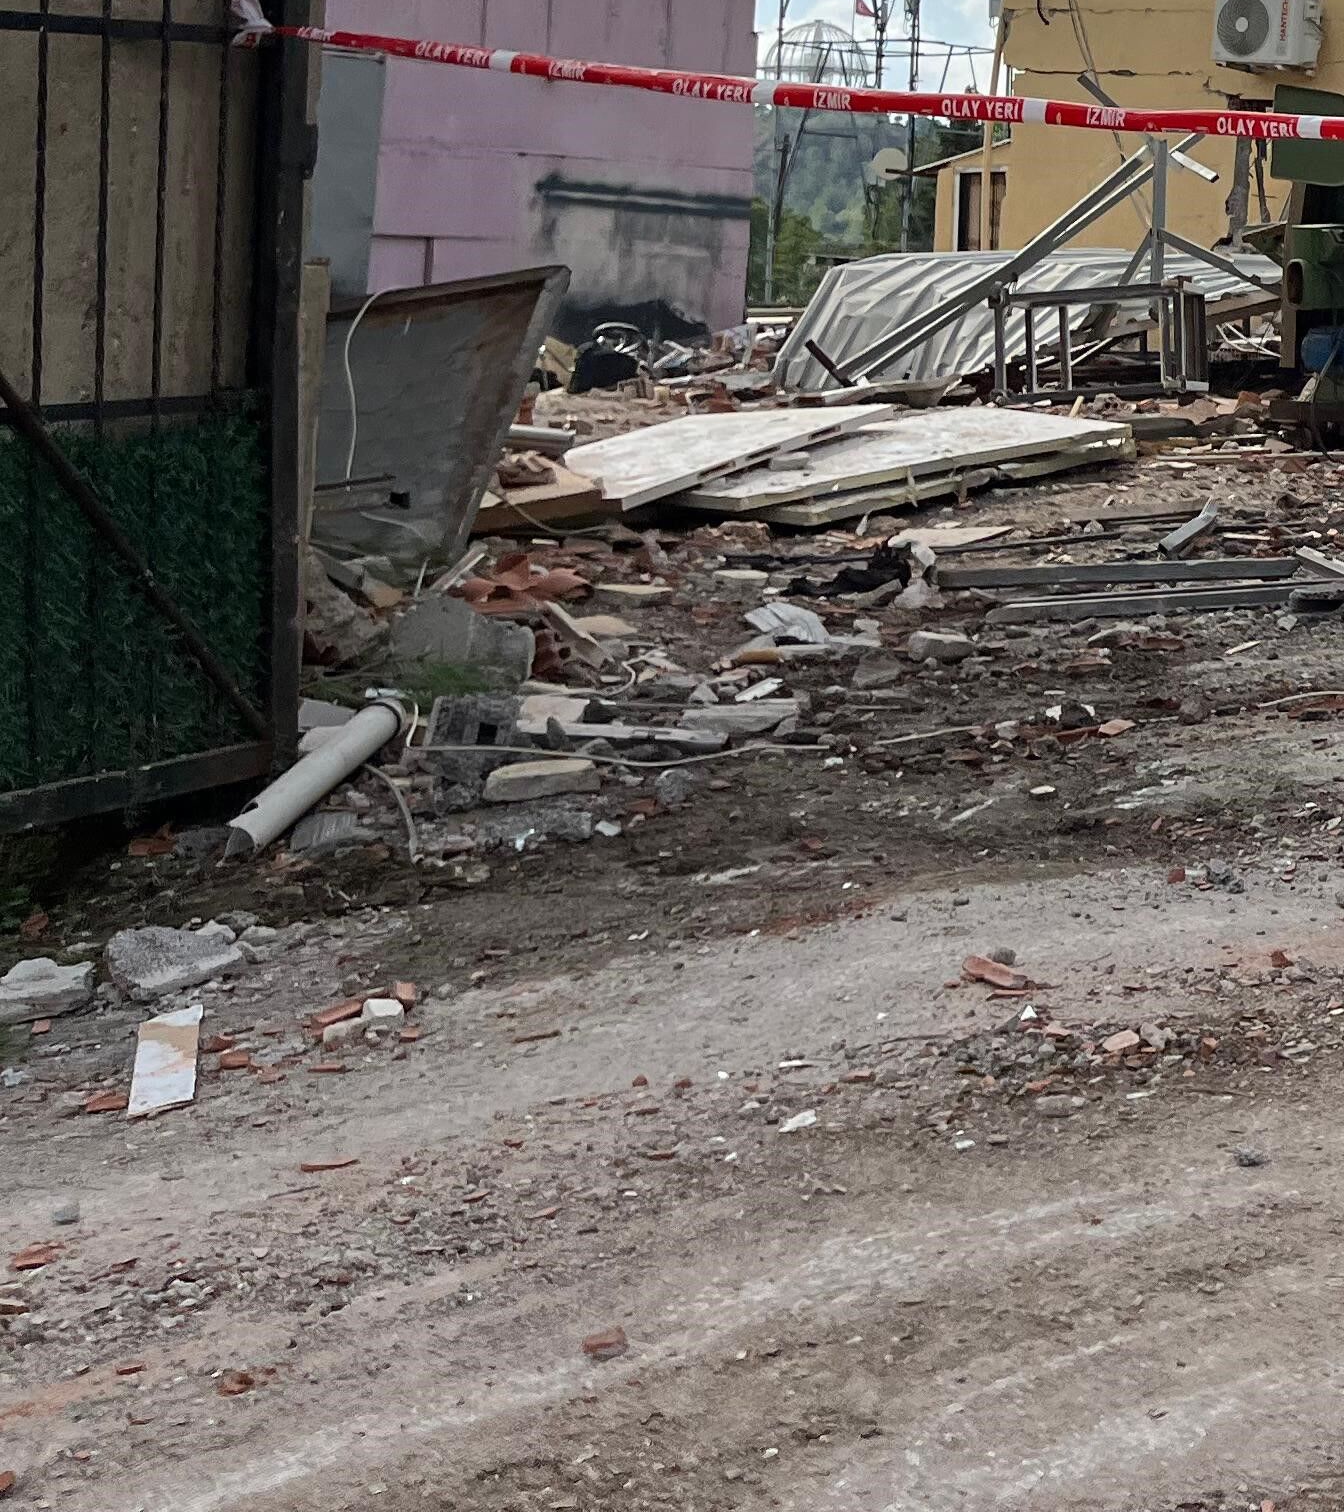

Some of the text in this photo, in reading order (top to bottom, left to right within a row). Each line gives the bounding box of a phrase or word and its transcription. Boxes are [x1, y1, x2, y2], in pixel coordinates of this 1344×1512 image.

[672, 78, 712, 99] OLAY
[813, 90, 1020, 120] İZMİR OLAY YERİ
[1217, 117, 1256, 136] OLAY
[1260, 119, 1295, 138] YERİ
